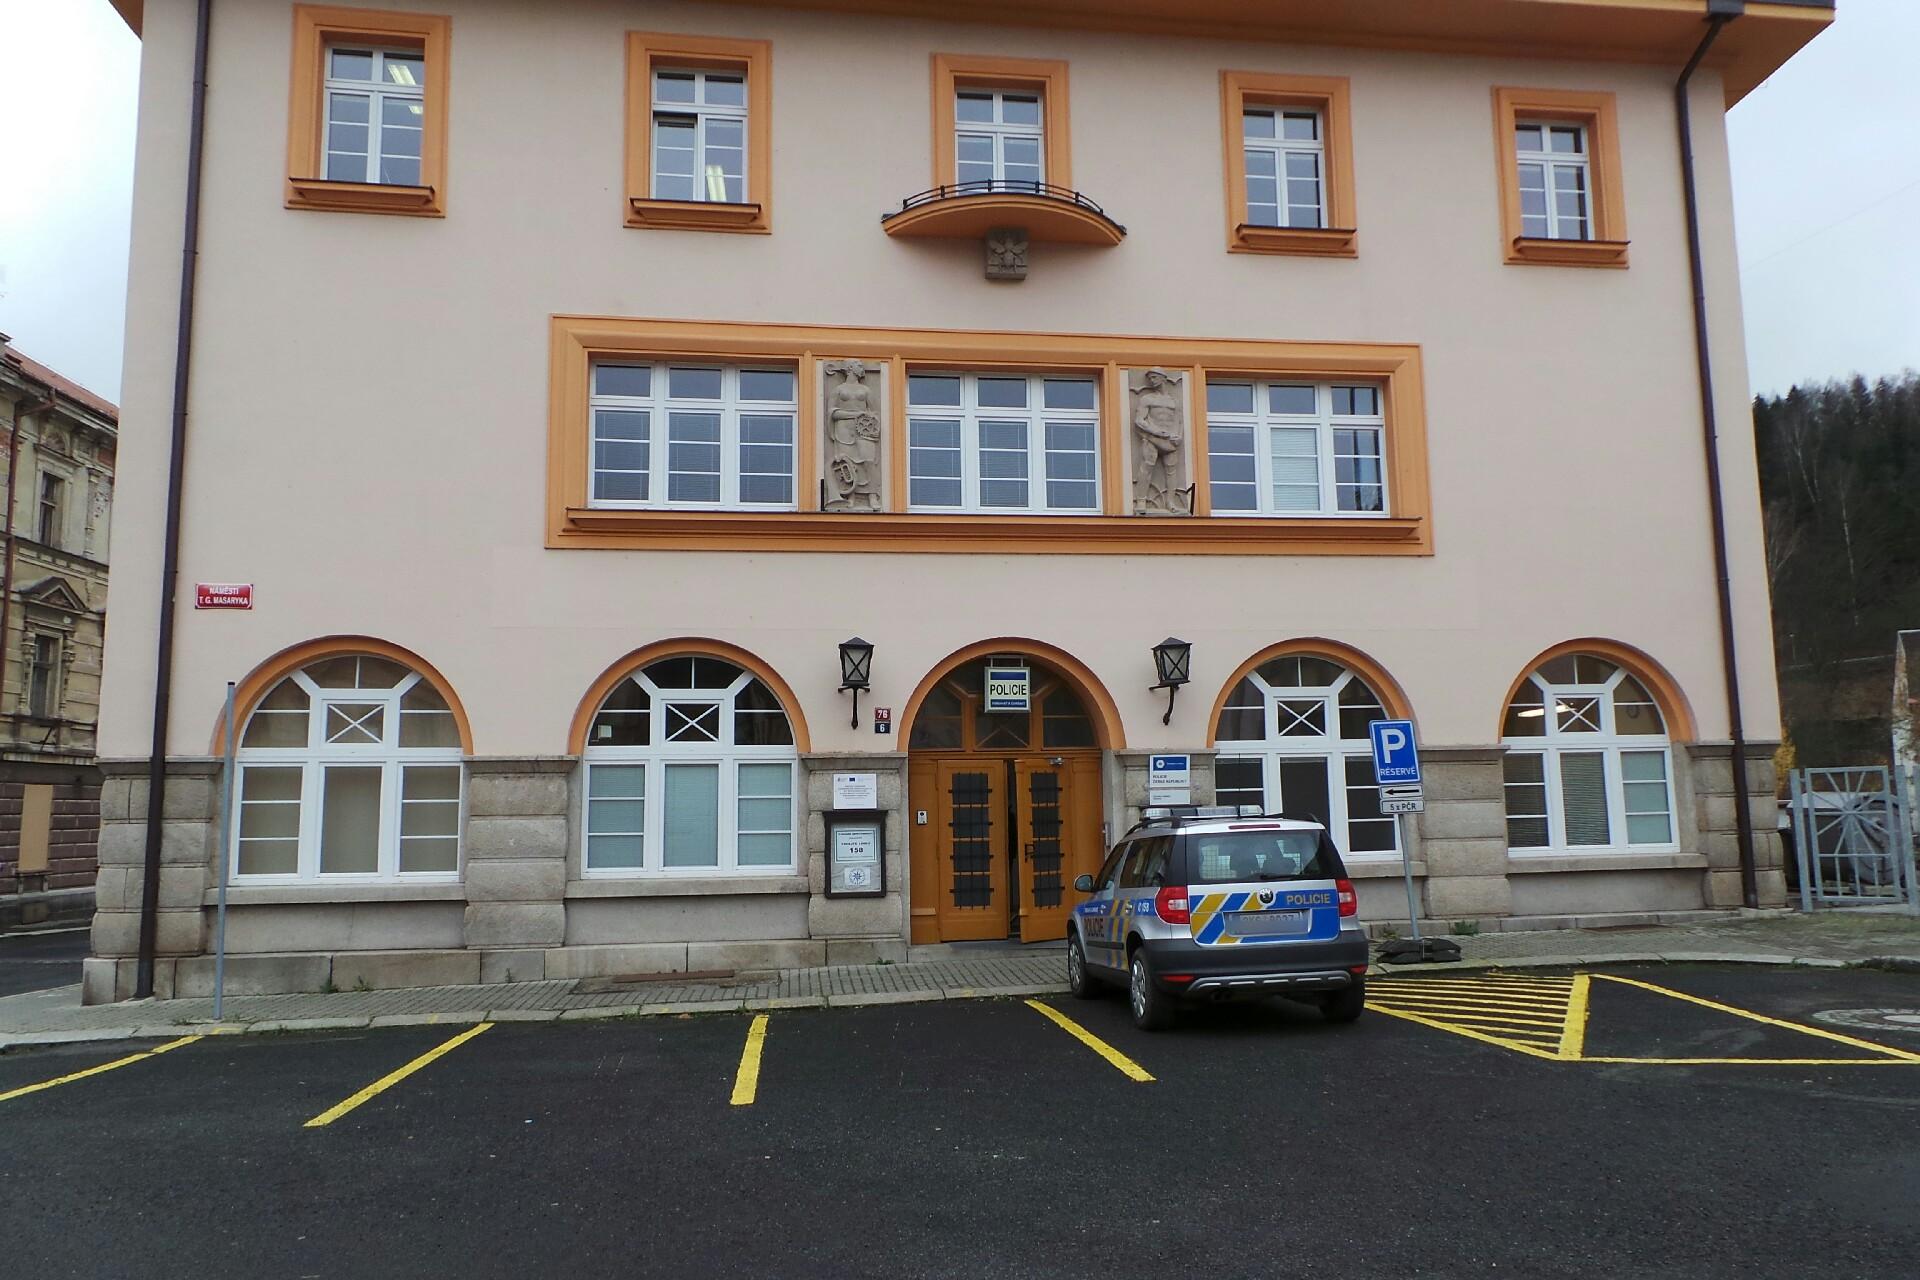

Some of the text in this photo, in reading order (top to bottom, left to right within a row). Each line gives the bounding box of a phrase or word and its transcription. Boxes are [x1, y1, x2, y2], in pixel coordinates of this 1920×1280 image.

[199, 596, 249, 605] T. G. MASARYKA
[990, 684, 1027, 696] POLICIE
[877, 709, 888, 719] 76
[879, 723, 886, 733] 6
[1381, 728, 1406, 764] P
[1380, 766, 1416, 776] RÉSERVÉ
[1402, 802, 1417, 811] PČR
[1286, 893, 1331, 905] POLICIE
